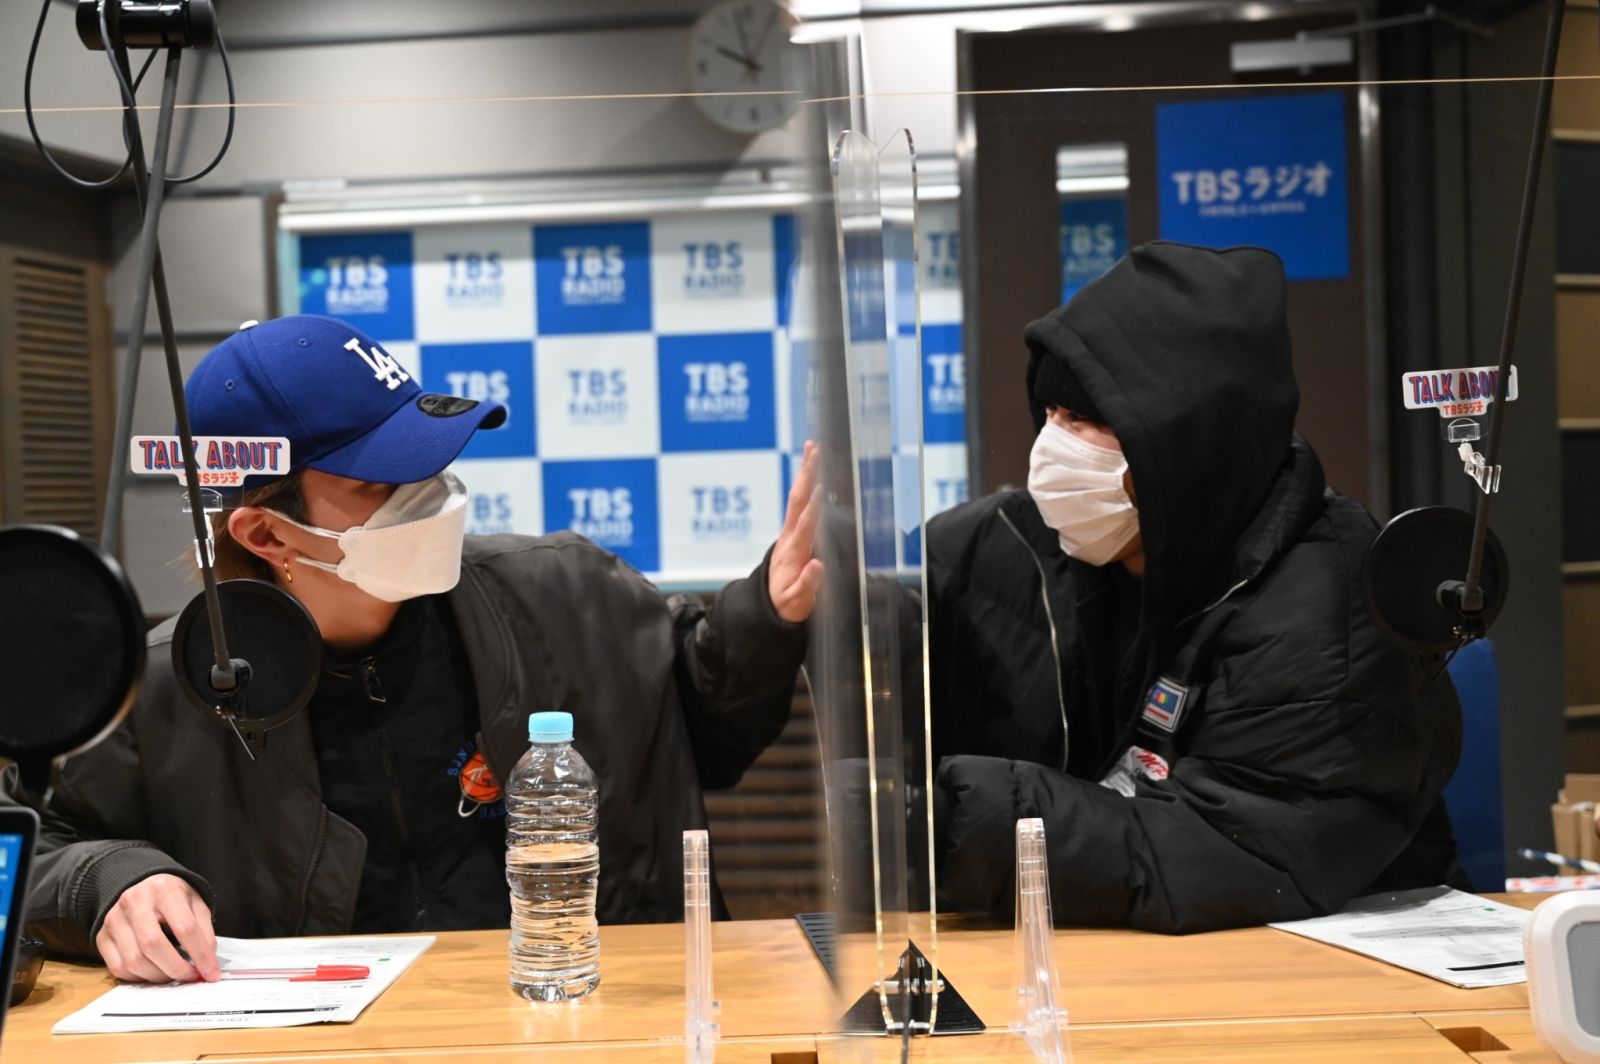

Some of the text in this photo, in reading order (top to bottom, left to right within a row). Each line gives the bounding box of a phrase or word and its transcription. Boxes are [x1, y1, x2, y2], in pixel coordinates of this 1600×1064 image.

[326, 255, 388, 287] TBS
[444, 251, 503, 281] TBS
[562, 246, 625, 278] TBS
[682, 241, 743, 270] TBS
[344, 338, 409, 390] LA
[684, 361, 749, 395] TBS
[446, 371, 510, 403] TBS
[567, 369, 627, 397] TBS
[1409, 370, 1512, 404] TALK ABOU
[206, 440, 282, 471] ABOUT
[469, 493, 513, 521] BS
[567, 487, 633, 519] TBS
[691, 485, 751, 515] TBS
